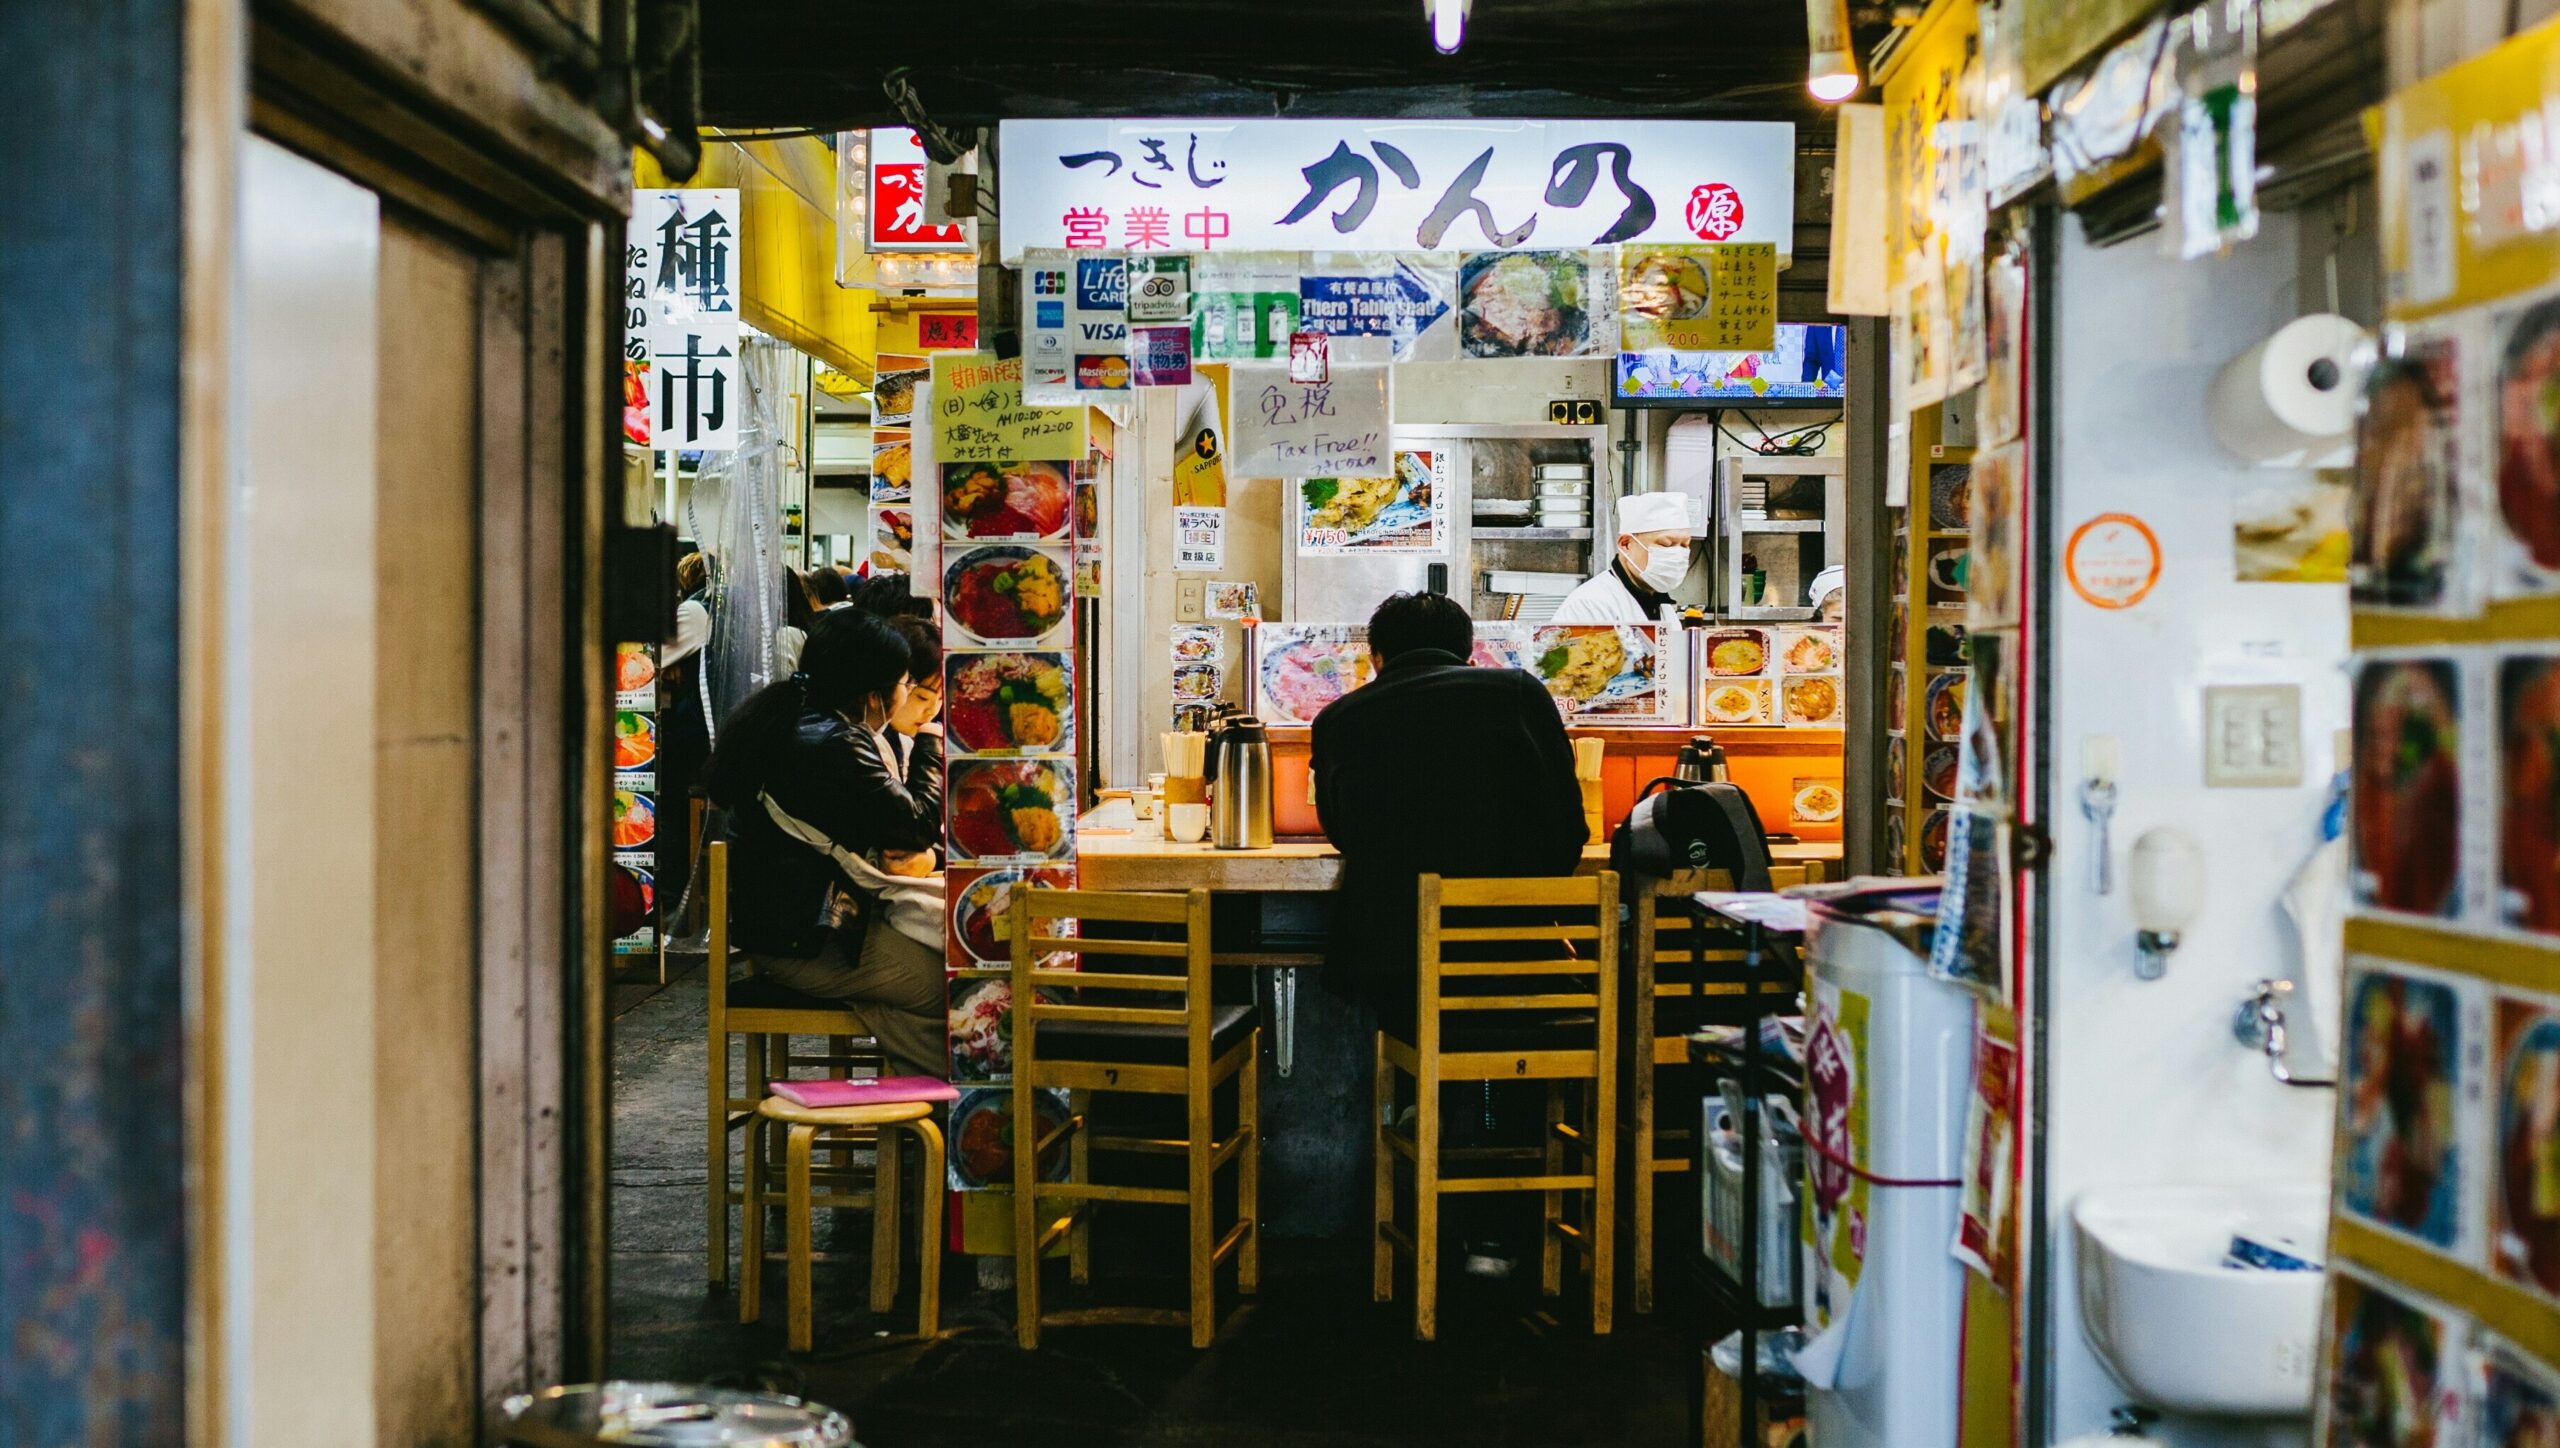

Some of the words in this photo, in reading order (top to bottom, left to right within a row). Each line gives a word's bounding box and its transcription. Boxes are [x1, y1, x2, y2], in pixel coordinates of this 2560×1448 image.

[1059, 132, 1228, 188] つきじ
[1274, 139, 1657, 249] かんの
[1689, 187, 1741, 238] 源
[1062, 206, 1230, 251] 営業中
[1720, 246, 1769, 257] ねぎとろ
[1720, 261, 1756, 272] はまち
[1083, 264, 1127, 290] Life
[1720, 275, 1757, 286] こはだ
[624, 243, 649, 361] たねいち
[1719, 290, 1769, 300] サーモン
[1134, 299, 1182, 310] tripadvisor
[1302, 298, 1348, 316] There
[1350, 298, 1392, 316] Table
[1720, 304, 1770, 316] えんがわ
[654, 208, 734, 443] 種市
[1080, 323, 1127, 340] VISA
[1719, 319, 1758, 330] 甘えび
[1079, 366, 1133, 378] MasterCard
[1261, 382, 1336, 427] 免税
[1270, 440, 1307, 461] Tax
[1314, 433, 1378, 457] Free!!
[1179, 518, 1220, 529] 黒ラベル
[1305, 529, 1348, 545] ¥750
[1182, 551, 1216, 562] 取扱店
[1760, 689, 1770, 719] メンマ
[1516, 1059, 1526, 1076] 8
[1104, 1069, 1118, 1085] 7
